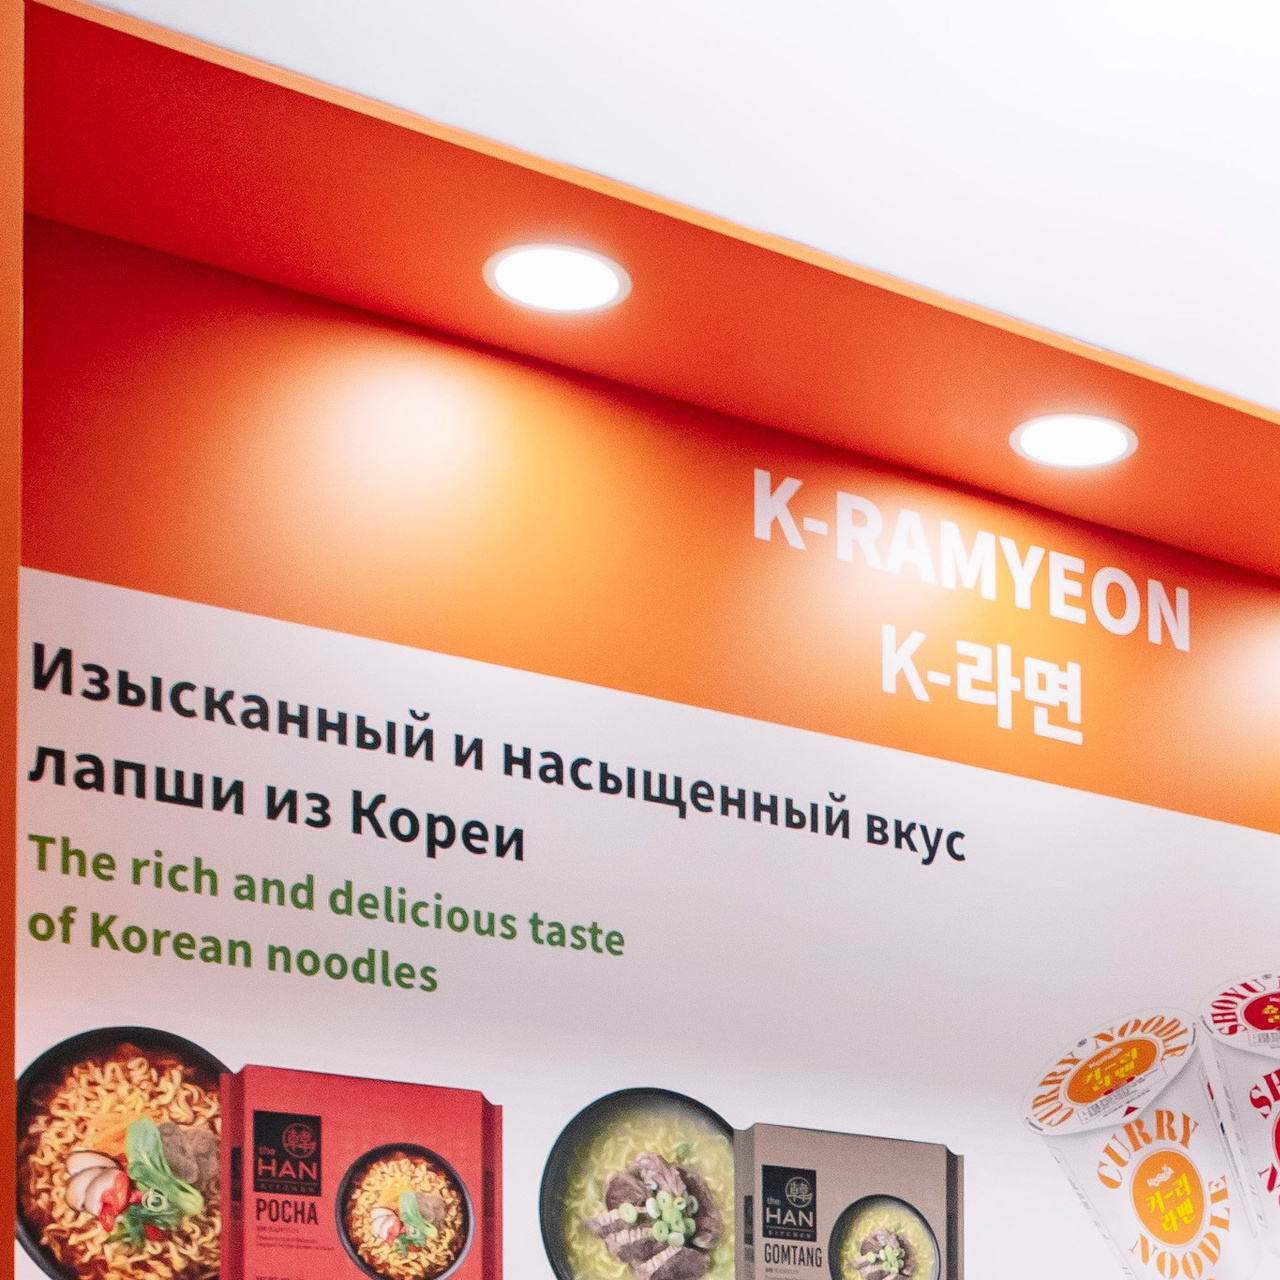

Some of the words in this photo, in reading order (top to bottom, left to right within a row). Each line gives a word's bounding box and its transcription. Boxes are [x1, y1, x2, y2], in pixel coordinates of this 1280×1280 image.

[754, 467, 1190, 653] K-RAMYEON
[881, 623, 1084, 745] K-라면
[31, 641, 435, 762] Изысканный
[453, 733, 484, 771] и
[503, 742, 851, 840] насыщенный
[866, 813, 966, 866] вкус
[27, 744, 245, 816] лапши
[266, 784, 331, 829] из
[352, 788, 524, 861] Кореи
[28, 833, 116, 882] The
[132, 849, 219, 897] rich
[234, 874, 314, 912] and
[328, 879, 517, 941] delicious
[529, 911, 625, 956] taste
[27, 905, 77, 944] of
[90, 911, 252, 969] Korean
[268, 941, 439, 993] noodles
[1211, 979, 1266, 1036] SHOYU
[1031, 1051, 1082, 1127] CURRY
[1094, 1015, 1189, 1062] NOODLE
[258, 1158, 317, 1181] HAN
[1096, 1109, 1199, 1190] CURRY
[255, 1198, 318, 1225] POCHA
[764, 1243, 822, 1268] GOMTANG
[766, 1207, 814, 1228] HAN
[1129, 1175, 1230, 1280] NOODLE
